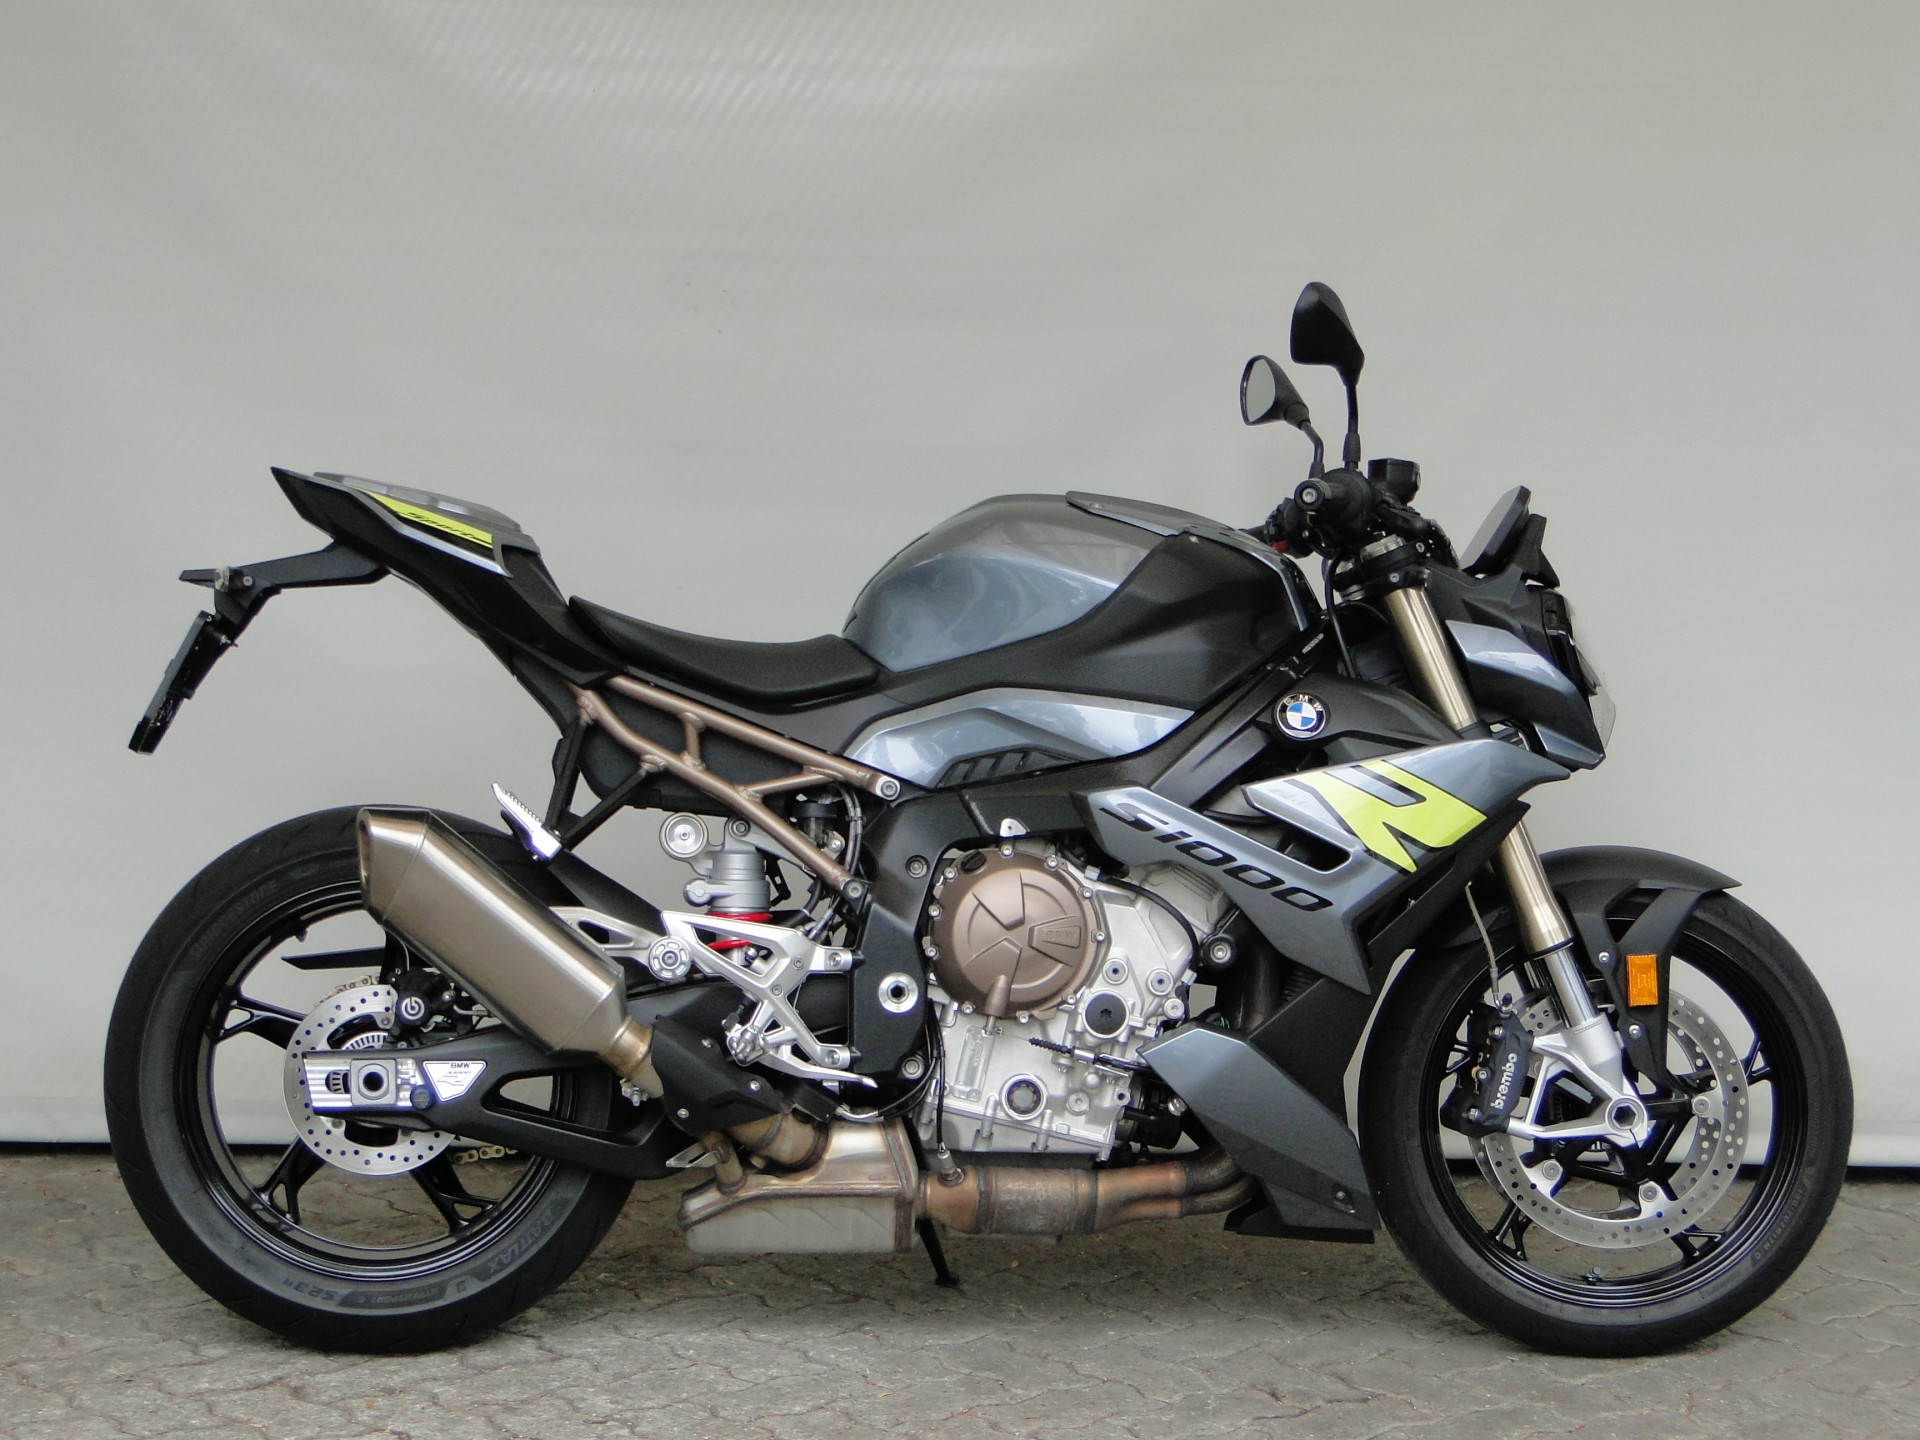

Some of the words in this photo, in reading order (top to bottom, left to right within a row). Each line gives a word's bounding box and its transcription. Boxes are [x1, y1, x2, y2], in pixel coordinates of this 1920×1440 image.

[1284, 694, 1323, 711] BMW
[1099, 802, 1334, 912] S1000
[1490, 1053, 1518, 1110] brembo
